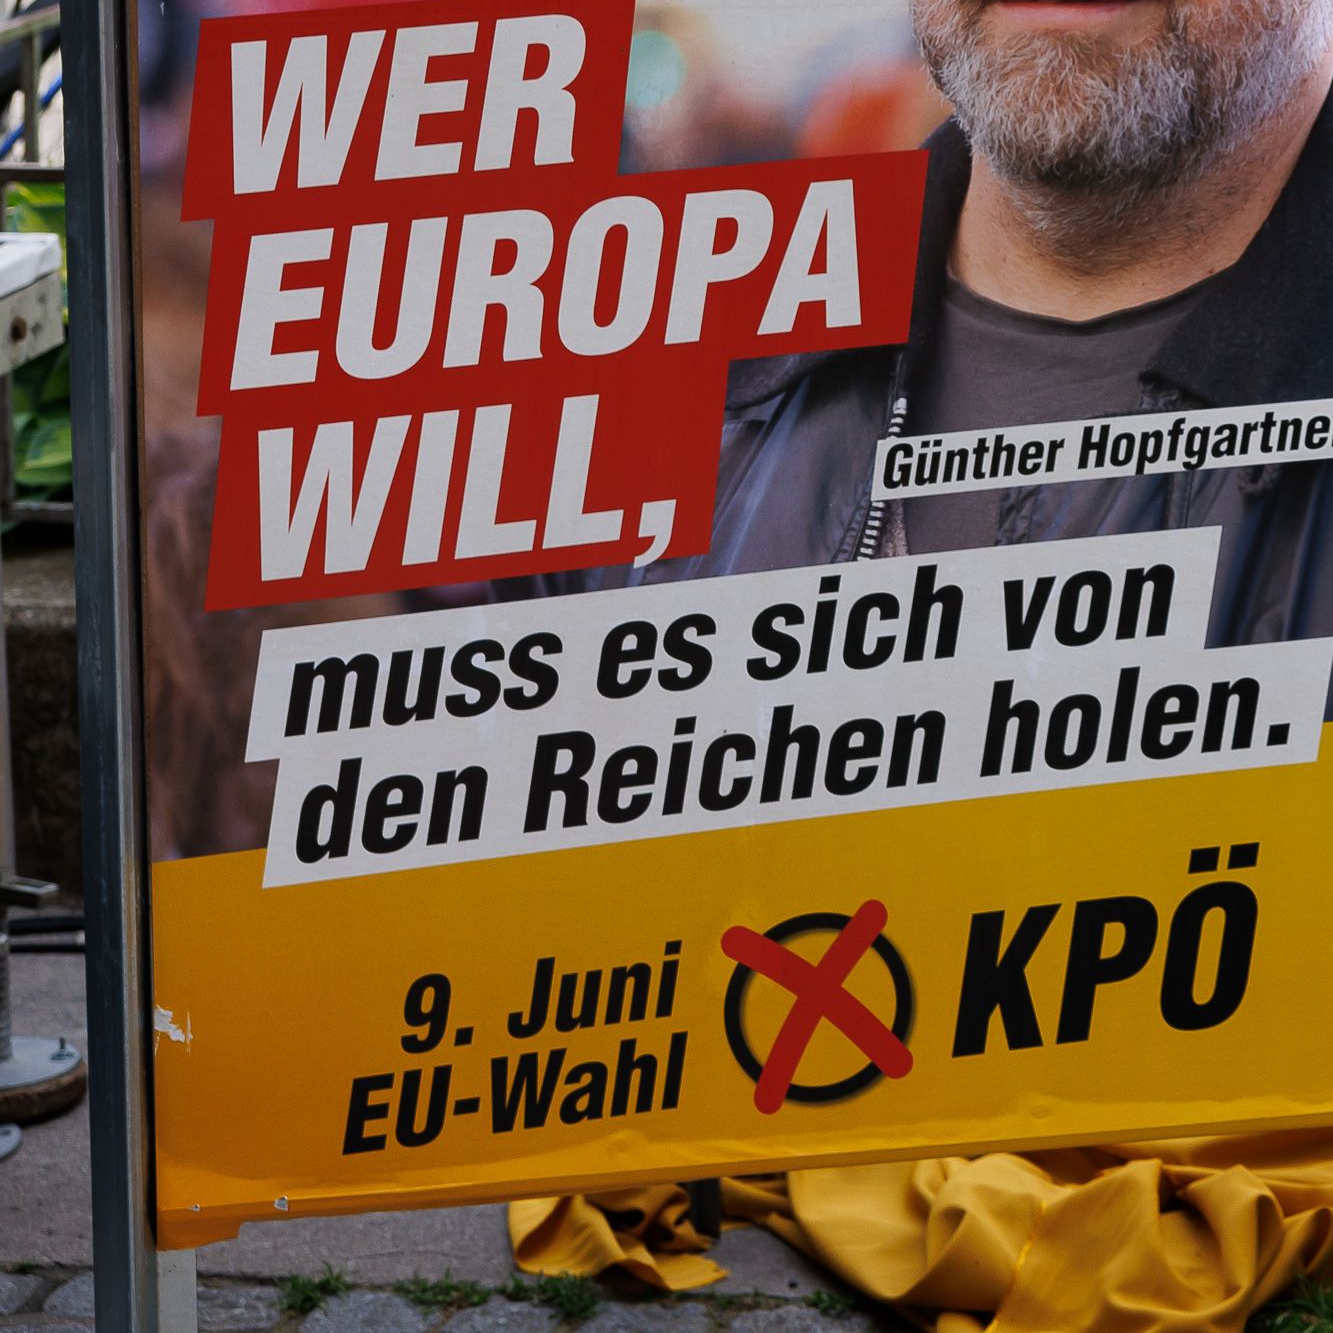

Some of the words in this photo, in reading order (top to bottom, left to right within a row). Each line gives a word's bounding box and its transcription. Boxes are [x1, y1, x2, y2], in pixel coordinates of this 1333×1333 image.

[232, 15, 585, 194] WER
[230, 180, 861, 390] EUROPA
[259, 395, 676, 580] WILL,
[884, 435, 1065, 489] Günther
[285, 632, 562, 737] muss
[597, 614, 716, 698] es
[747, 565, 963, 680] sich
[1004, 564, 1174, 651] von
[296, 758, 488, 863] den
[524, 705, 945, 833] Reichen
[980, 667, 1290, 777] holen.
[400, 973, 474, 1054] 9.
[507, 939, 682, 1039] Juni
[951, 842, 1260, 1058] KPÖ
[341, 1026, 688, 1157] EU-Wahl
